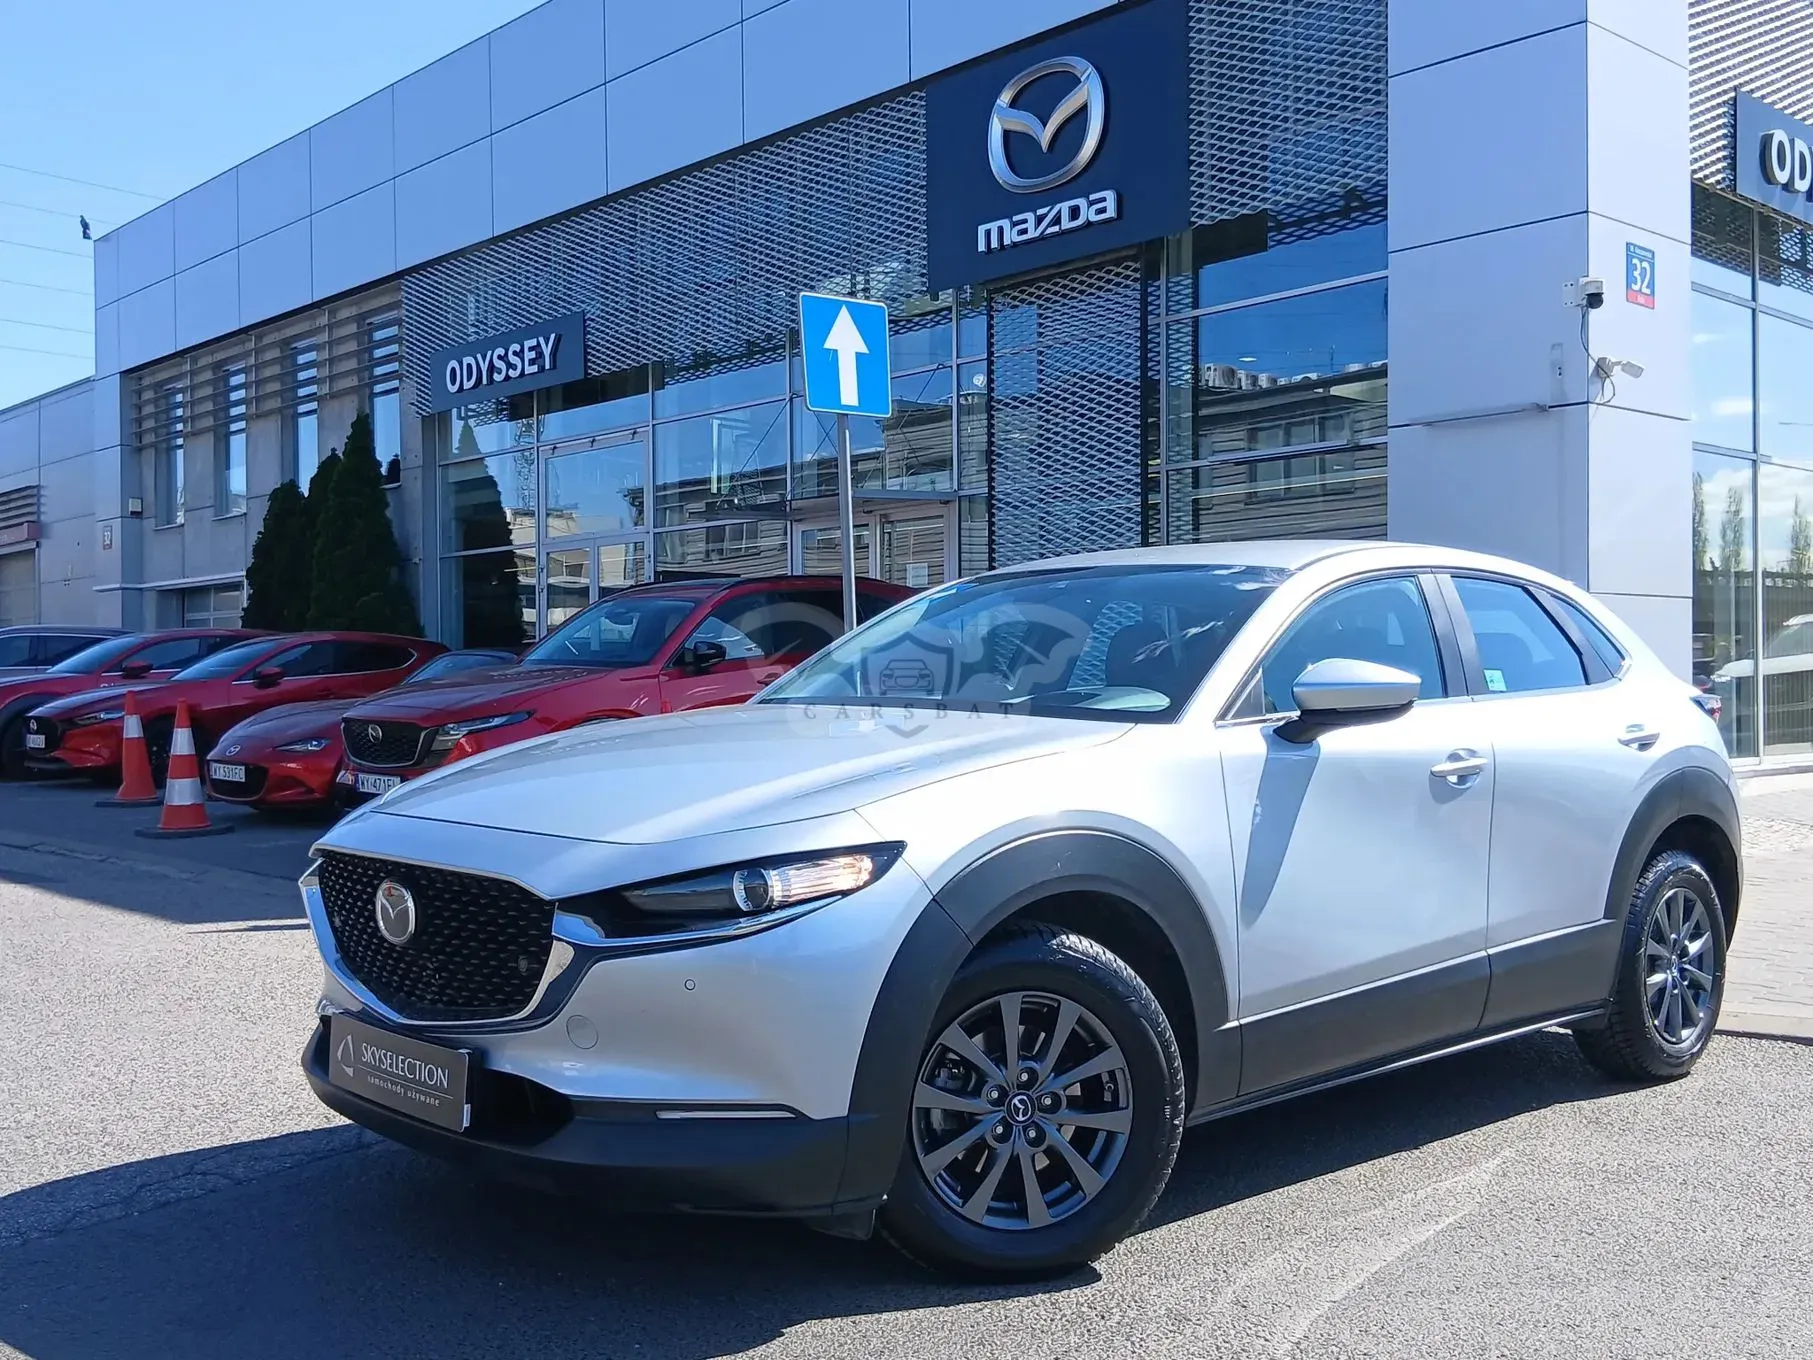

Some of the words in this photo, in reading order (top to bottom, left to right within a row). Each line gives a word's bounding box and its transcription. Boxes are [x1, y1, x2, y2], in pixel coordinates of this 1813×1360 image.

[1767, 129, 1813, 193] OD
[1631, 257, 1652, 295] 32
[445, 333, 558, 393] ODYSSEY
[360, 775, 370, 790] WY
[361, 1042, 449, 1089] SKYSELECTION
[367, 1075, 405, 1097] samochody
[407, 1090, 440, 1107] używane
